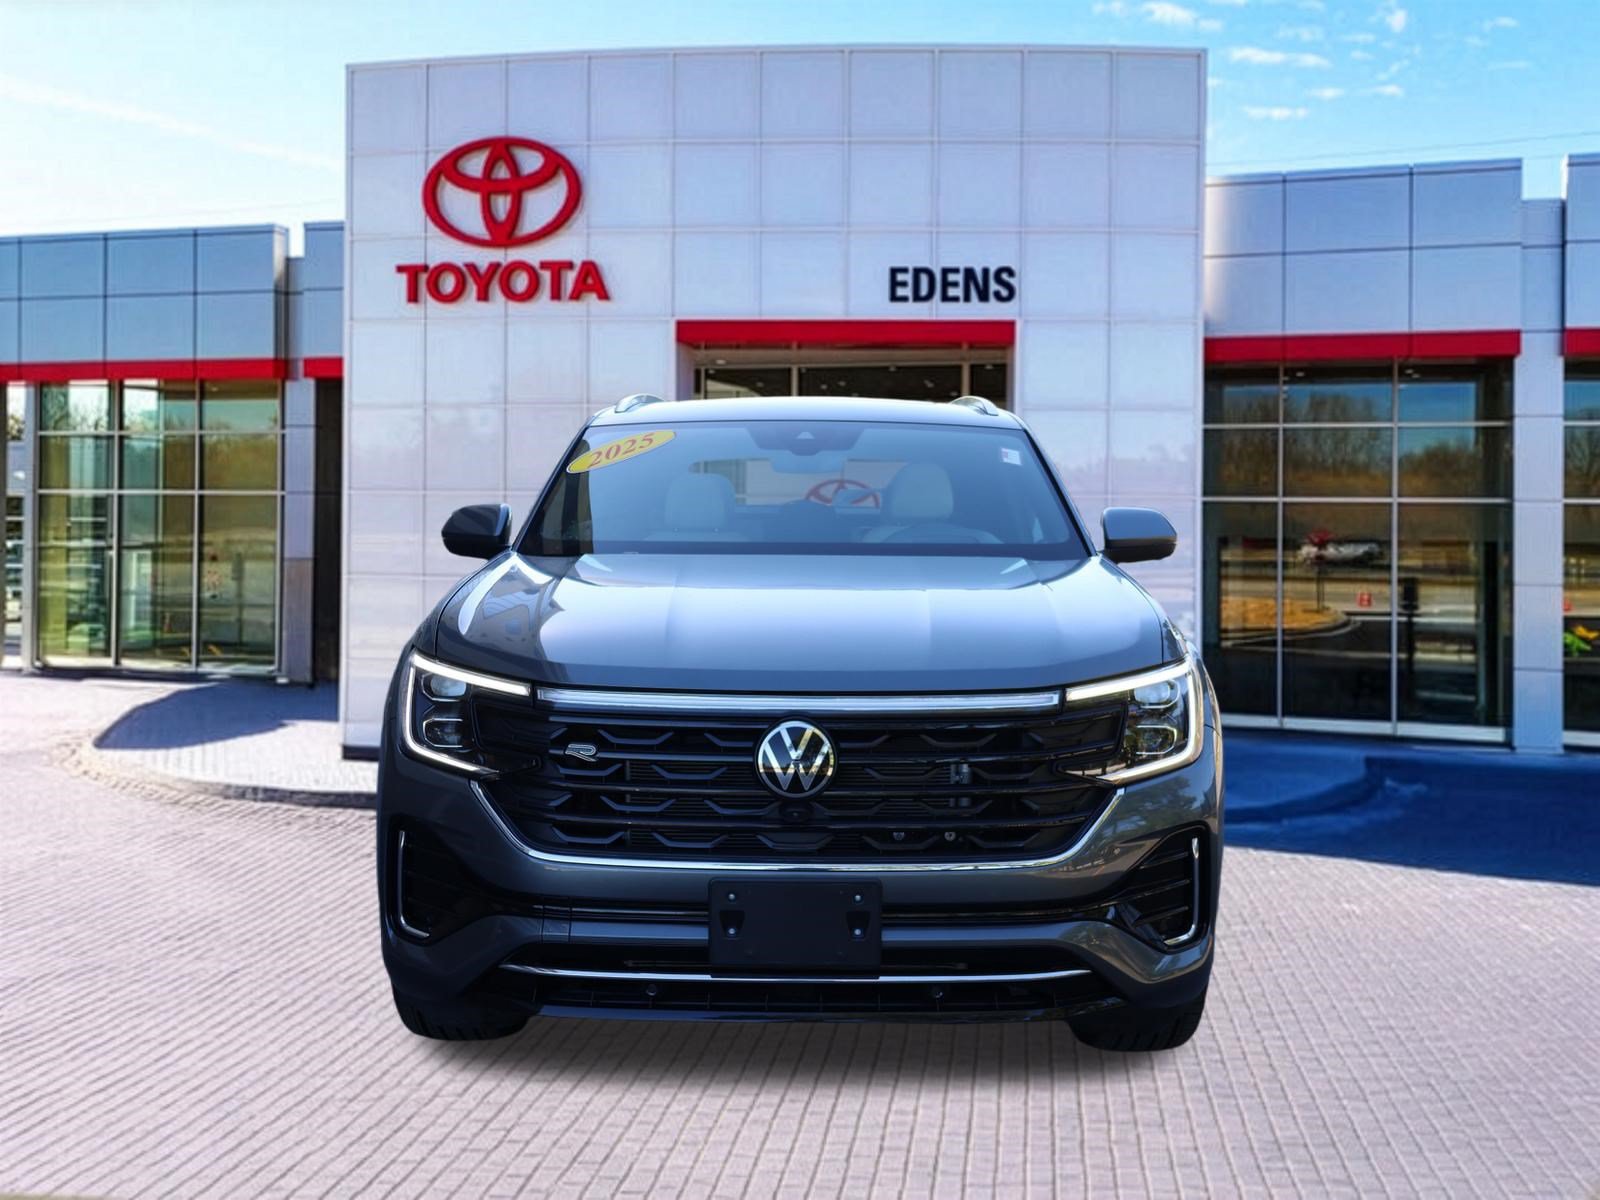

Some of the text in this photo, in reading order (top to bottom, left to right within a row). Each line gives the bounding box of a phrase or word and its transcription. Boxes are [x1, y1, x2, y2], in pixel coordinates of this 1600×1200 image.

[395, 260, 611, 304] TOYOTA
[889, 266, 1017, 303] EDENS
[587, 432, 656, 469] 2025
